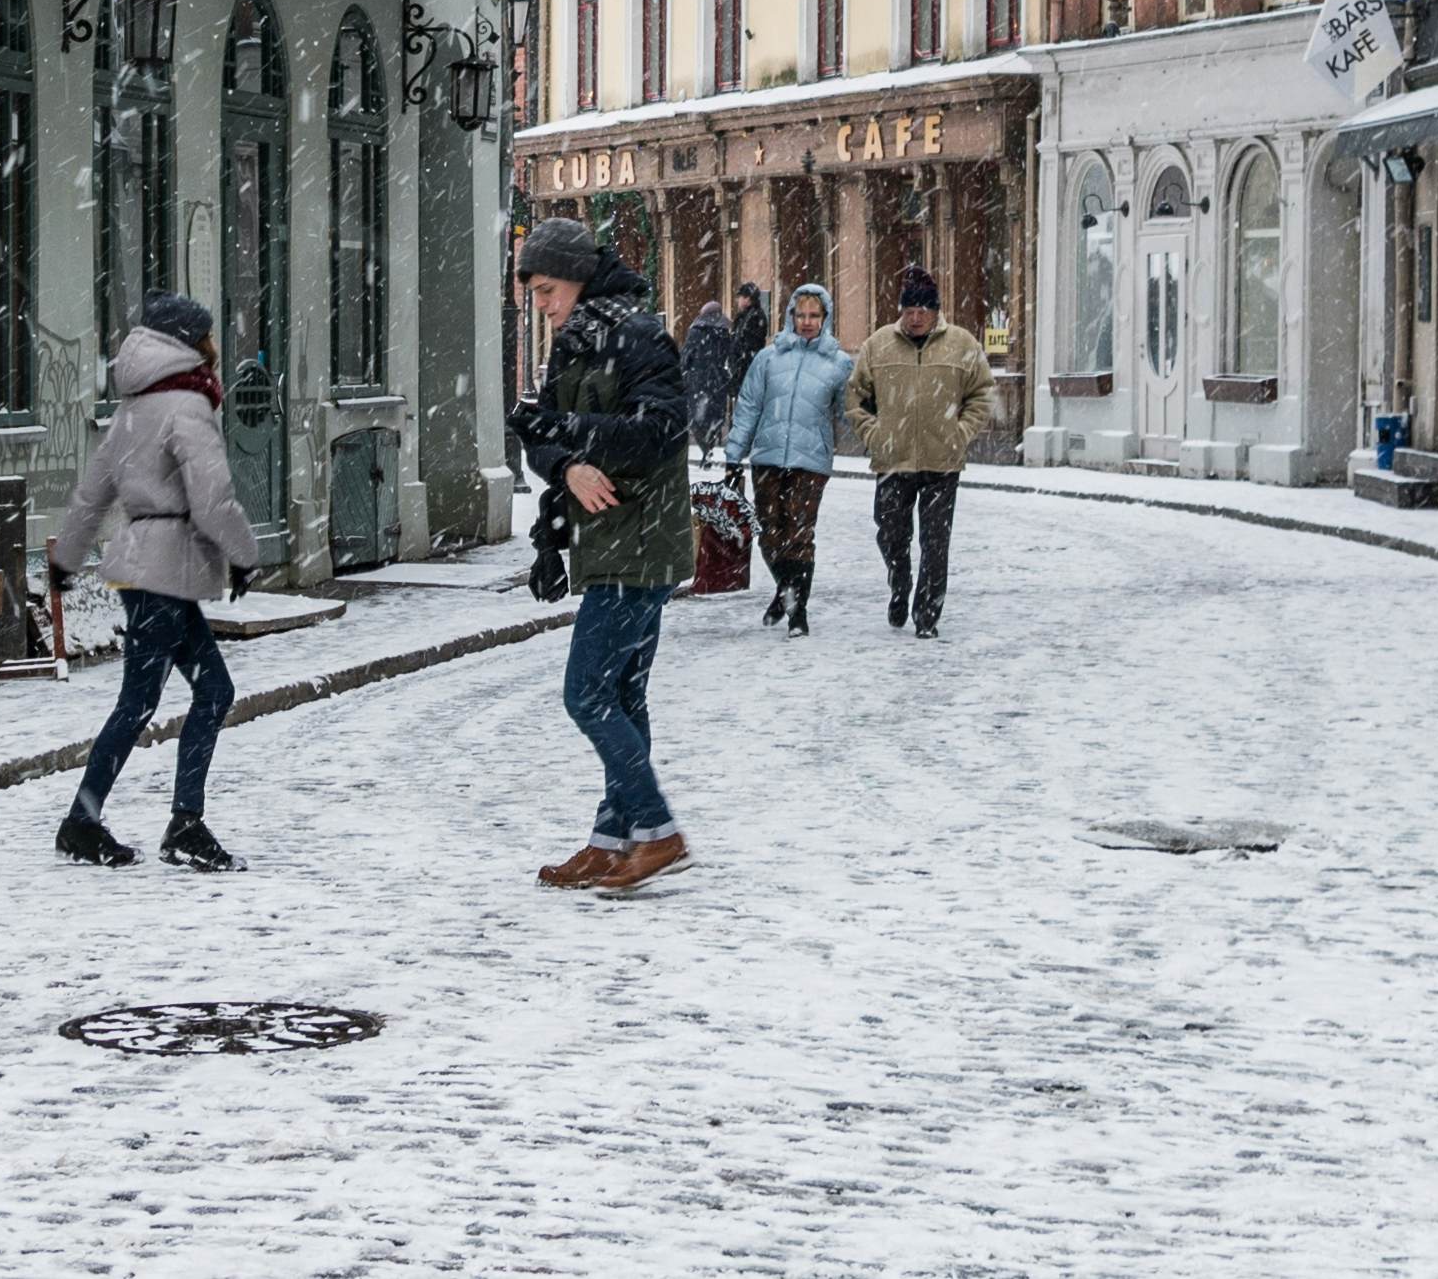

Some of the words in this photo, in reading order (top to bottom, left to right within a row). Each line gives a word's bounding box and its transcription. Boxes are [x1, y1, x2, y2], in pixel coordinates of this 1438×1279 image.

[1325, 28, 1380, 79] KAFĒ
[552, 151, 636, 191] CUBA
[836, 113, 944, 163] CAFE
